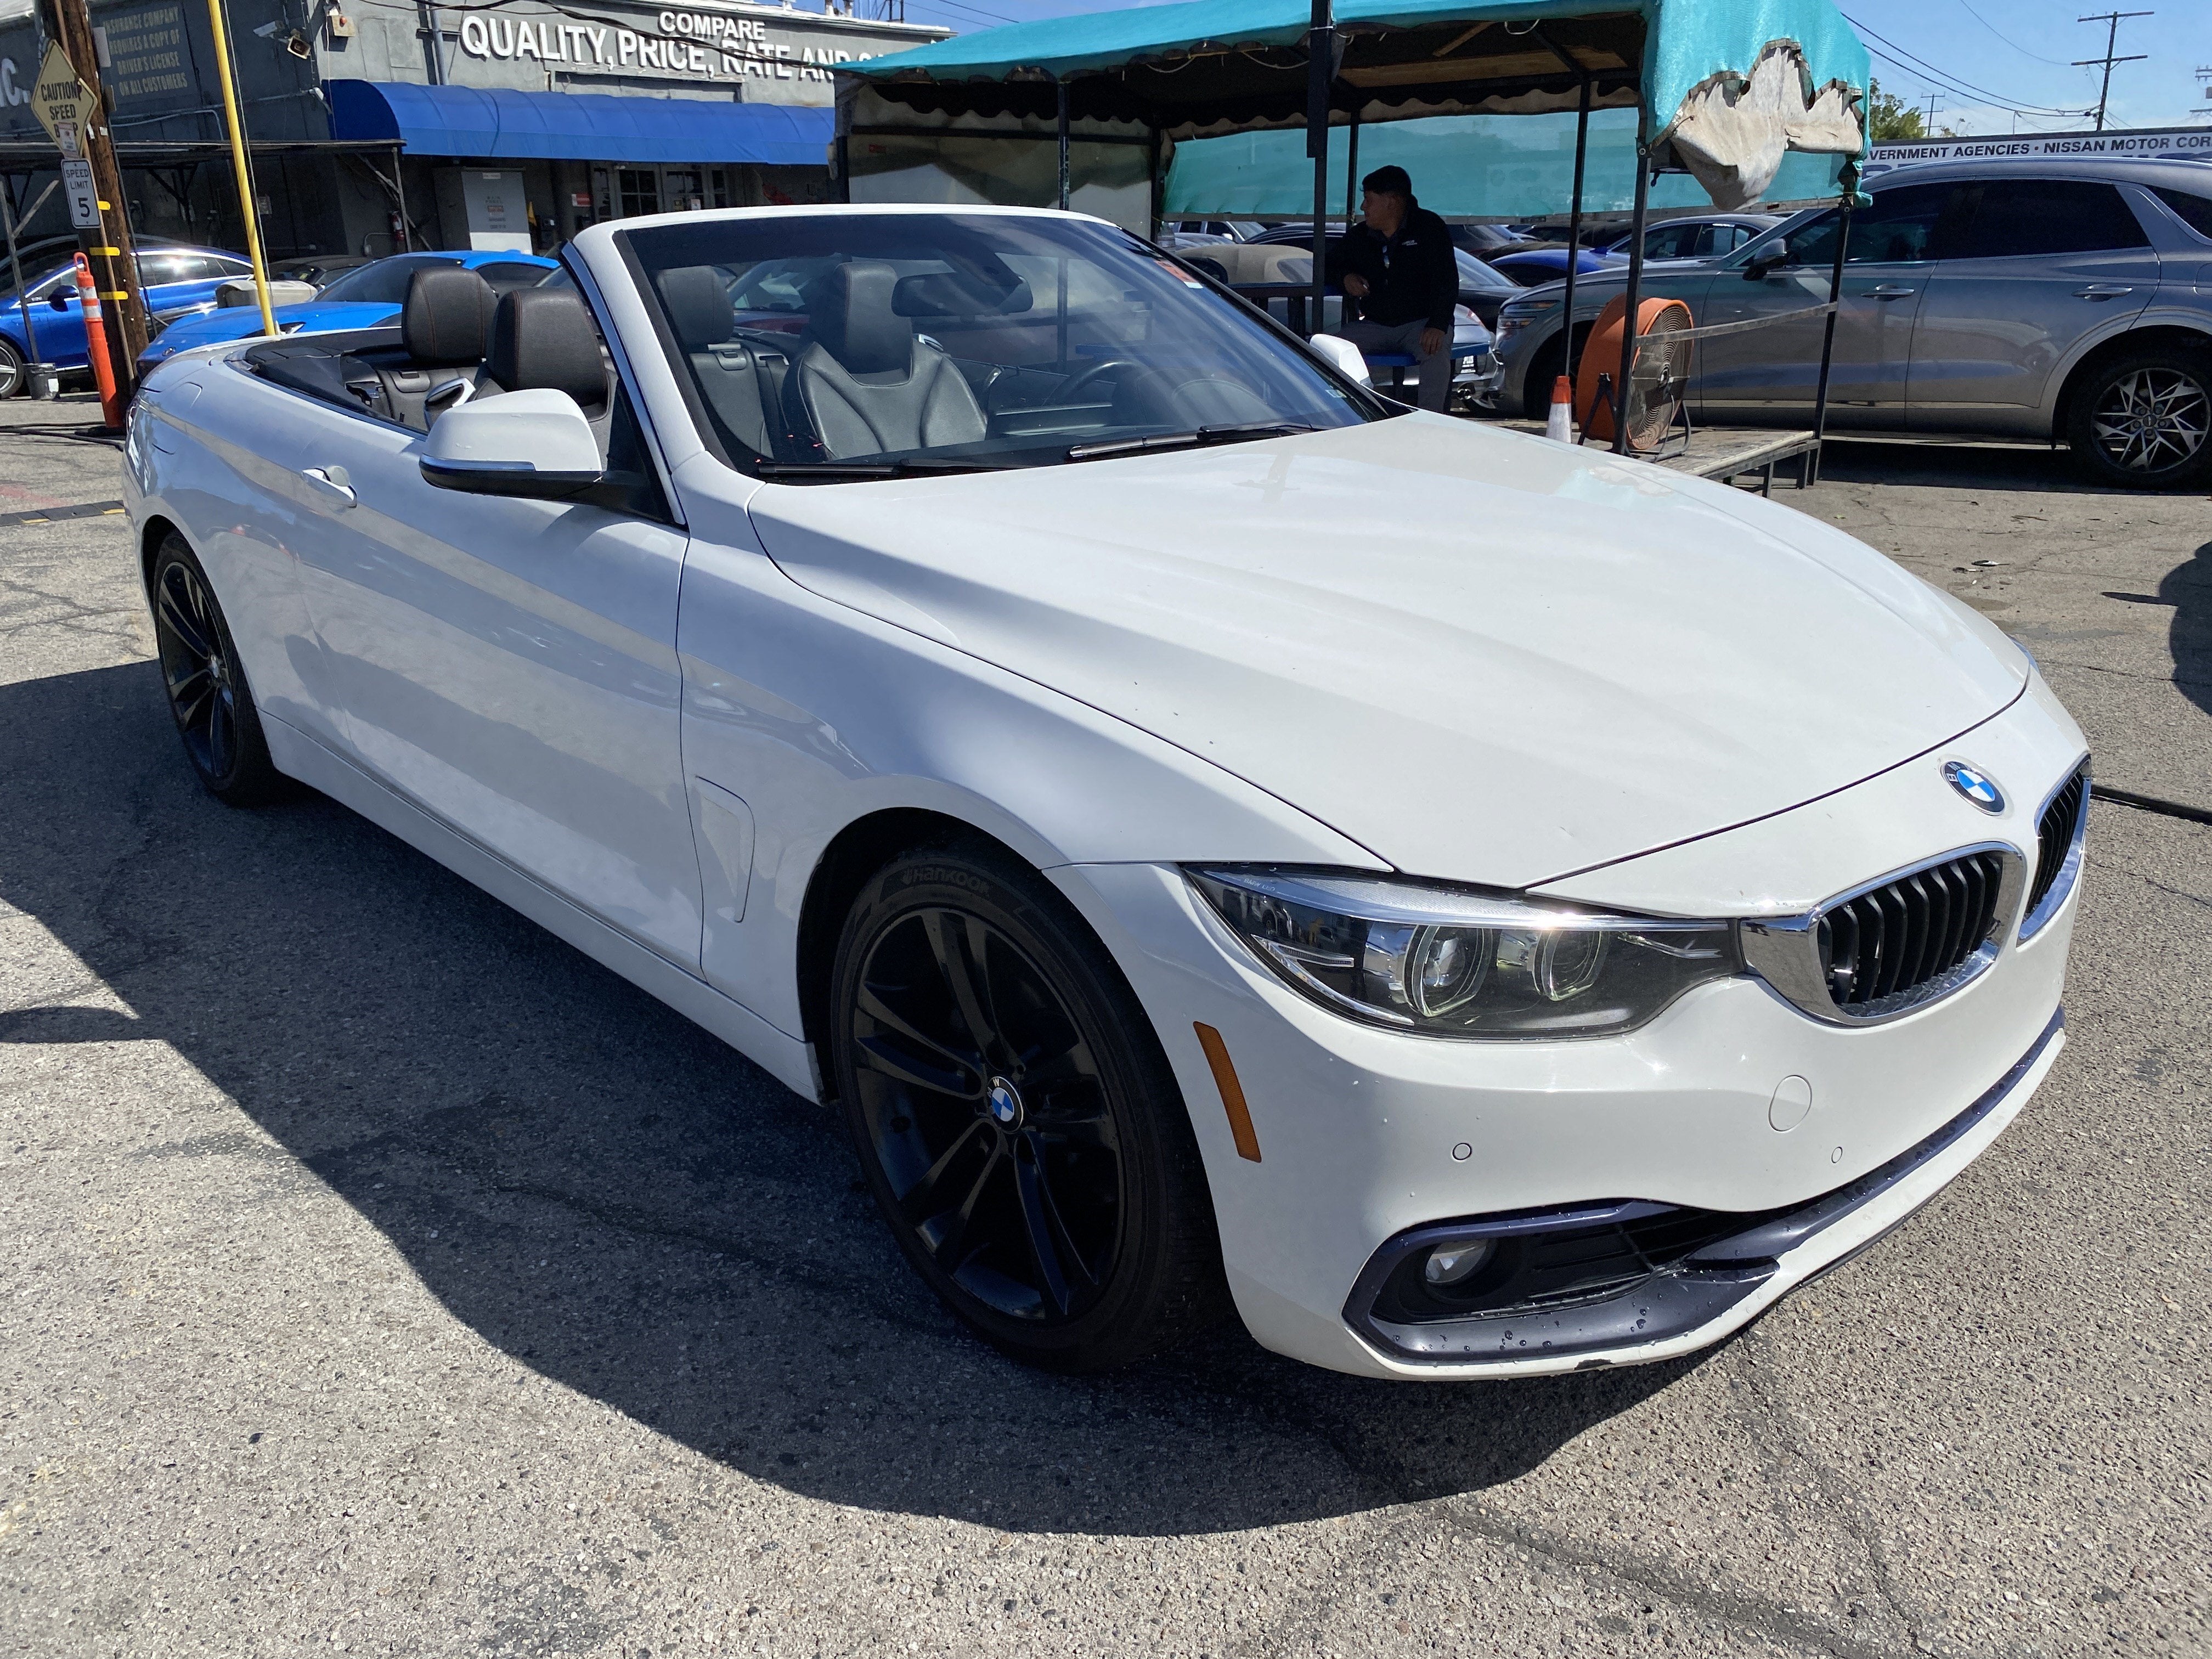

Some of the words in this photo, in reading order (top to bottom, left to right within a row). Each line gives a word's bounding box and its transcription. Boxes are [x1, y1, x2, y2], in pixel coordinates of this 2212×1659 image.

[143, 6, 179, 27] COMPANY
[659, 11, 766, 41] COMPARE
[143, 35, 149, 49] A
[149, 30, 169, 48] COPY
[170, 29, 180, 45] OF
[461, 15, 614, 71] QUALITY,
[617, 30, 714, 78] PRICE,
[721, 39, 793, 78] RATE
[117, 56, 149, 75] DRIVER'S
[149, 51, 180, 70] LICENSE
[0, 58, 30, 108] C.
[41, 81, 78, 102] CAUTION
[119, 81, 131, 97] ON
[130, 80, 143, 95] ALL
[142, 72, 188, 93] CUSTOMERS
[49, 103, 77, 120] SPEED
[53, 122, 78, 138] BP
[1869, 146, 1950, 161] VERNMENT
[1953, 143, 2030, 157] AGENCIES
[2044, 140, 2106, 154] NISSAN
[2111, 137, 2170, 151] MOTOR
[2176, 136, 2212, 148] COR
[65, 169, 89, 178] SPEED
[70, 180, 88, 190] LIMIT
[78, 197, 91, 218] 5
[1244, 878, 1261, 887] BMW
